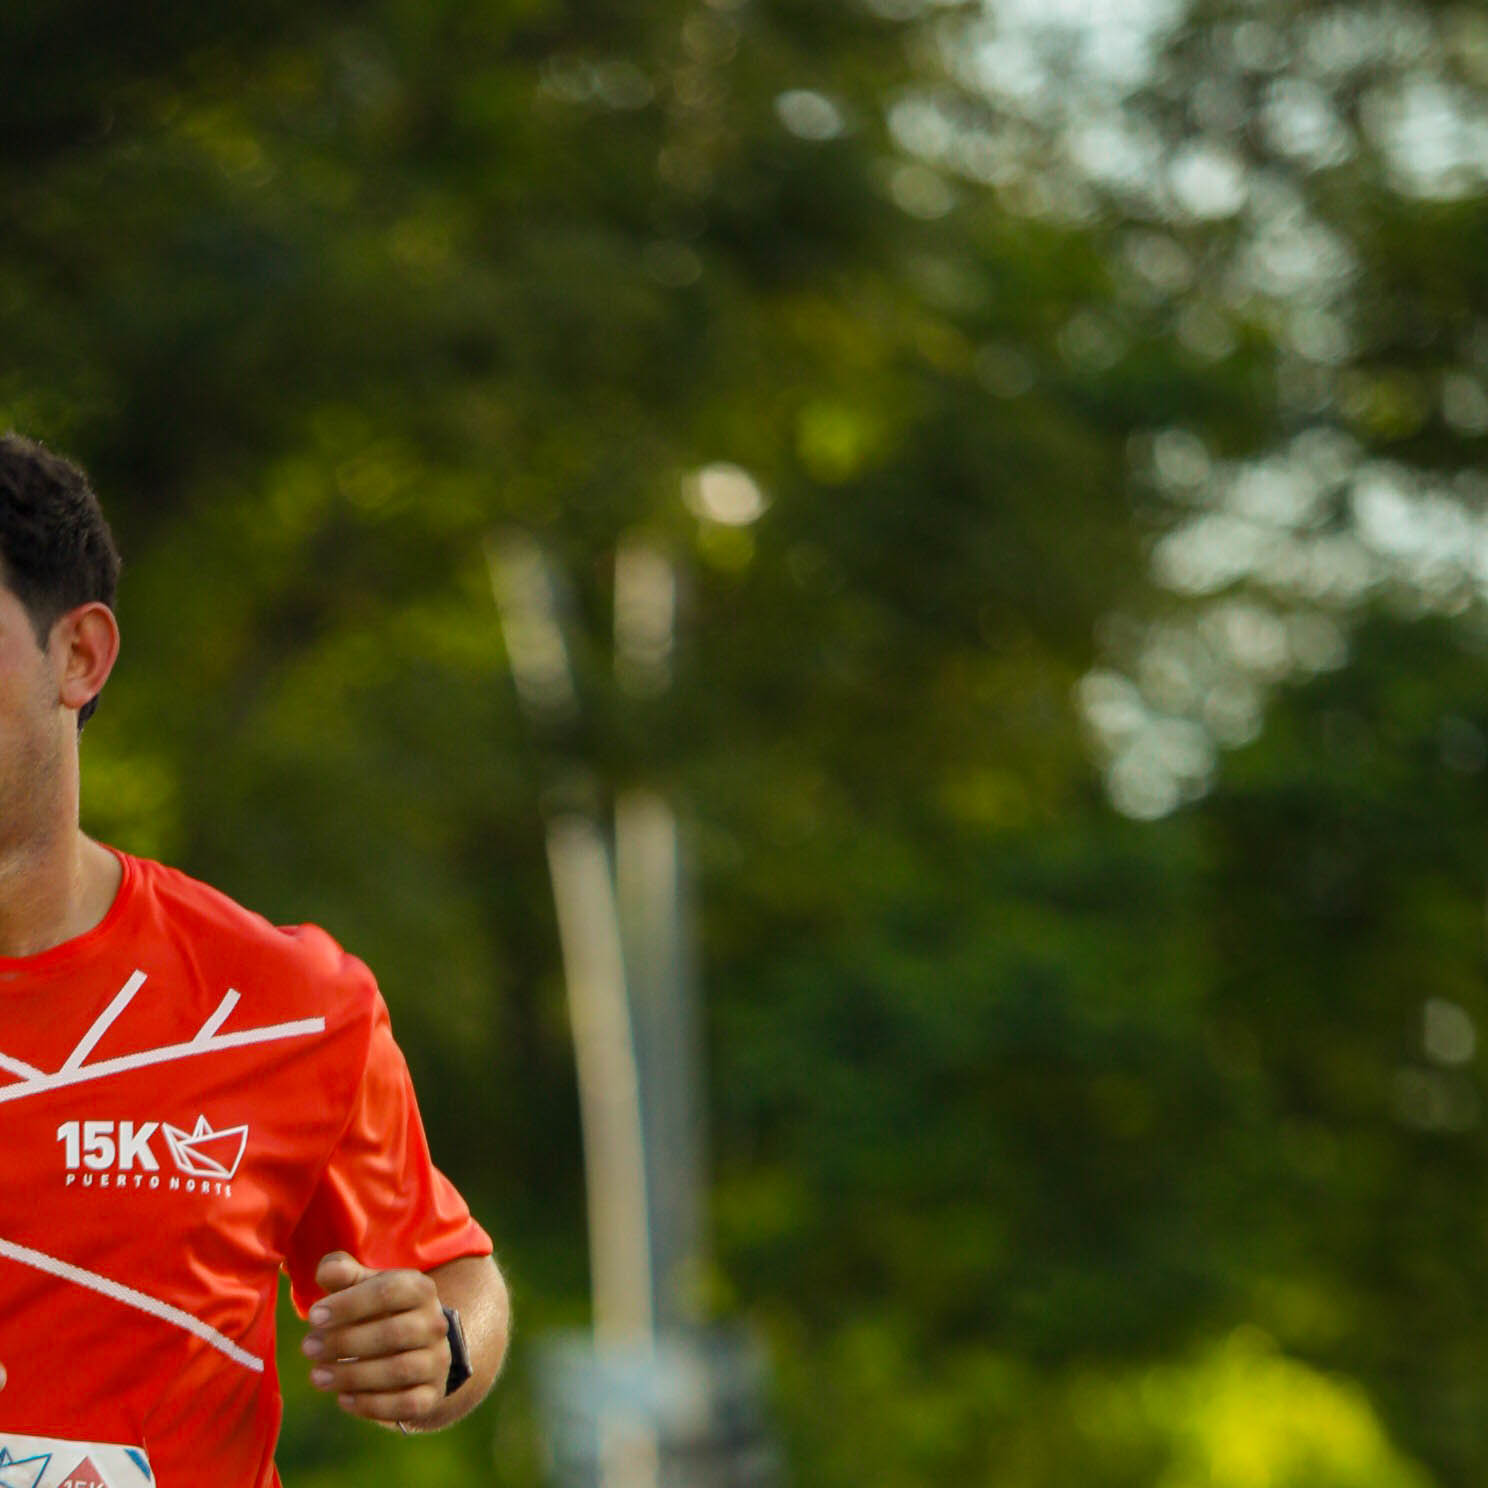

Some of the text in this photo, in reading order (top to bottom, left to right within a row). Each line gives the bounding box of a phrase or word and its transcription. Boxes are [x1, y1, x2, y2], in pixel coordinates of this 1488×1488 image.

[56, 1120, 160, 1171] 15K
[65, 1173, 232, 1198] PUERTO NORTE
